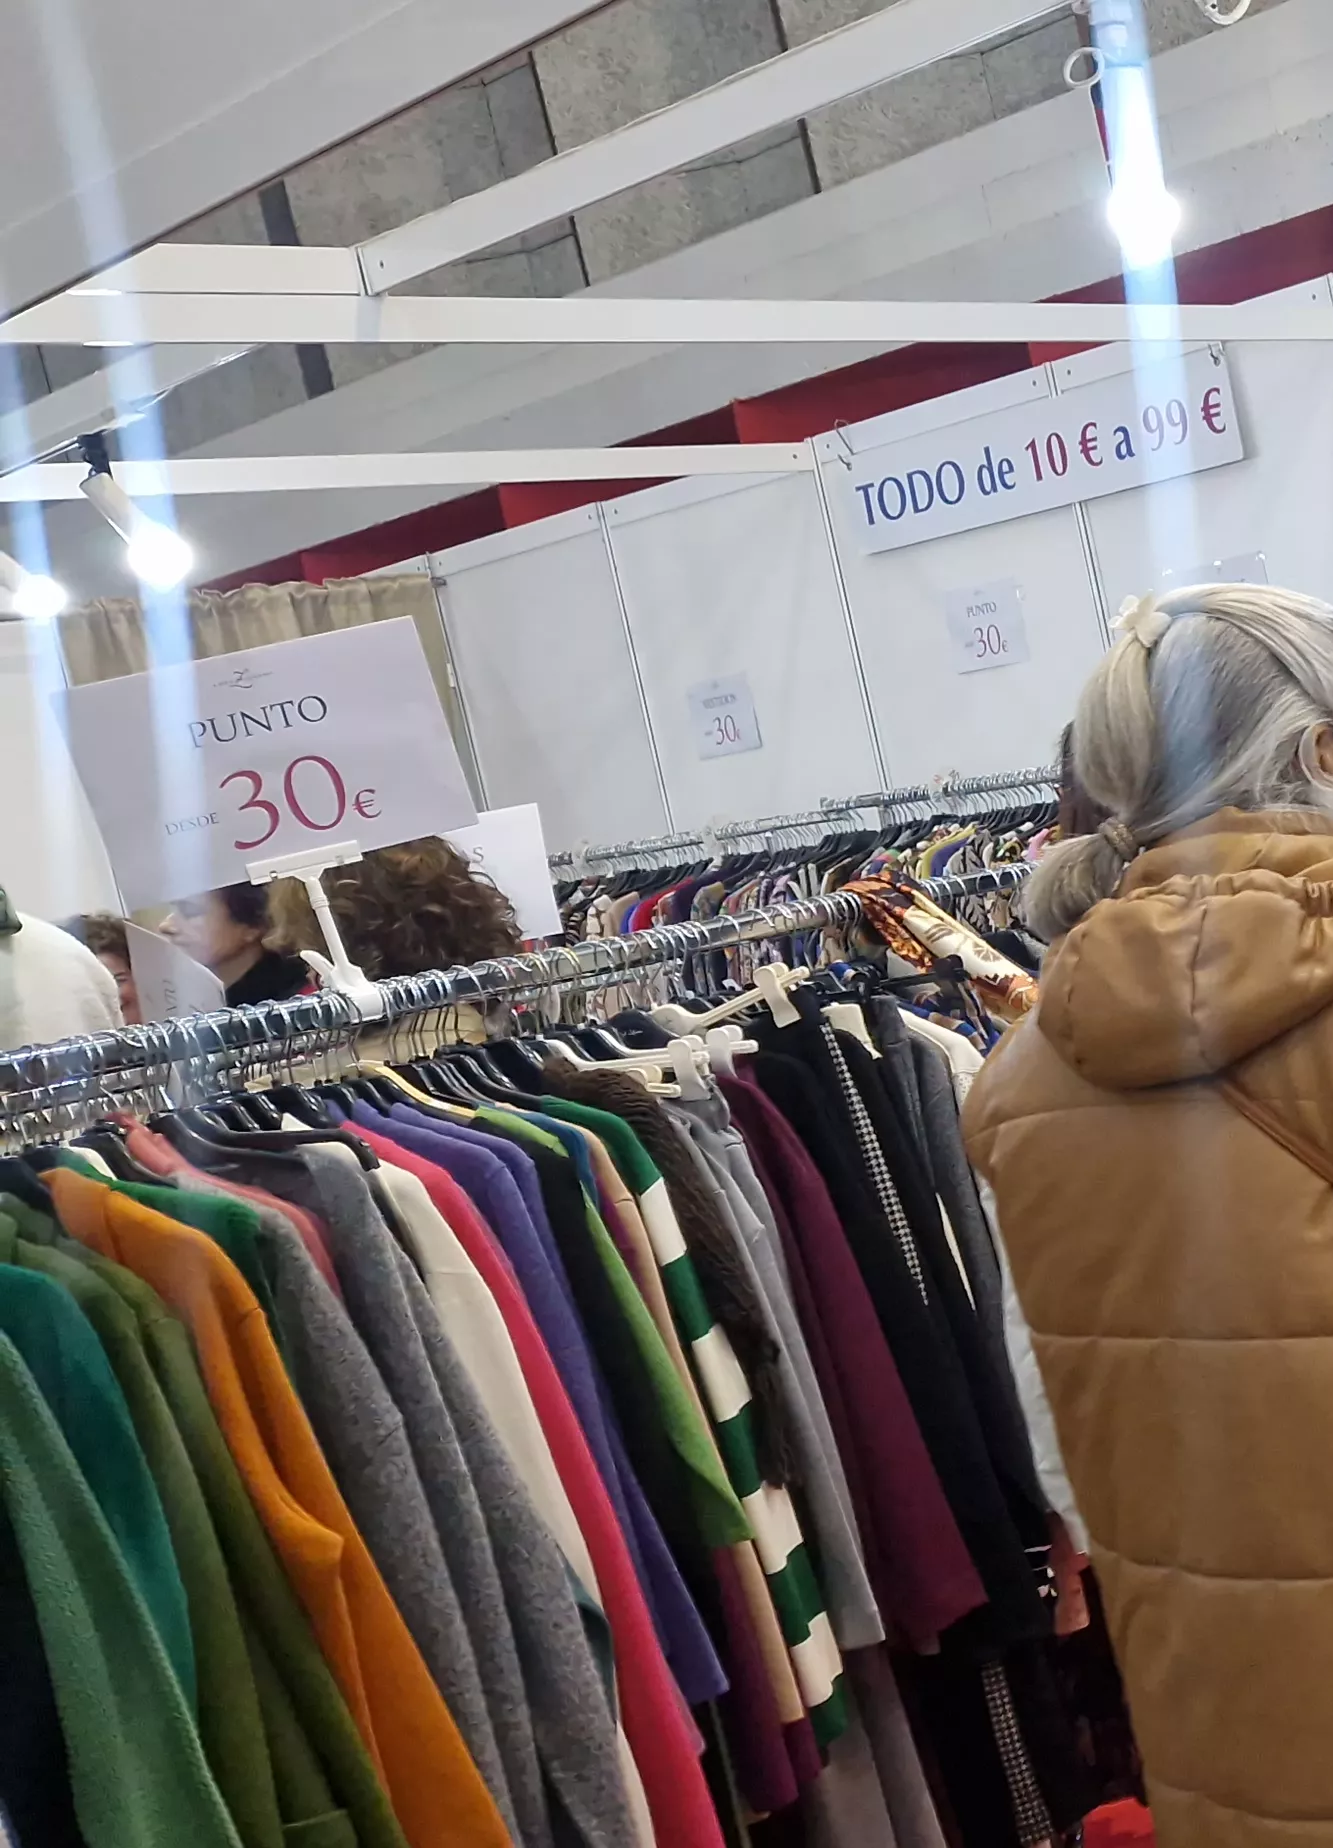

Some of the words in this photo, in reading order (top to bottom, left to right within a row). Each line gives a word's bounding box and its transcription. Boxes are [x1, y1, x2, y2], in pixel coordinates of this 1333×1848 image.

[855, 460, 966, 526] TODO
[977, 446, 1017, 496] de
[1024, 432, 1068, 482] 10
[1078, 421, 1103, 467] €
[1113, 425, 1136, 460] a
[1142, 398, 1188, 452] 99
[1201, 387, 1227, 435] €
[188, 695, 328, 749] PUNTO
[164, 812, 220, 836] DESDE
[219, 755, 382, 850] 30€
